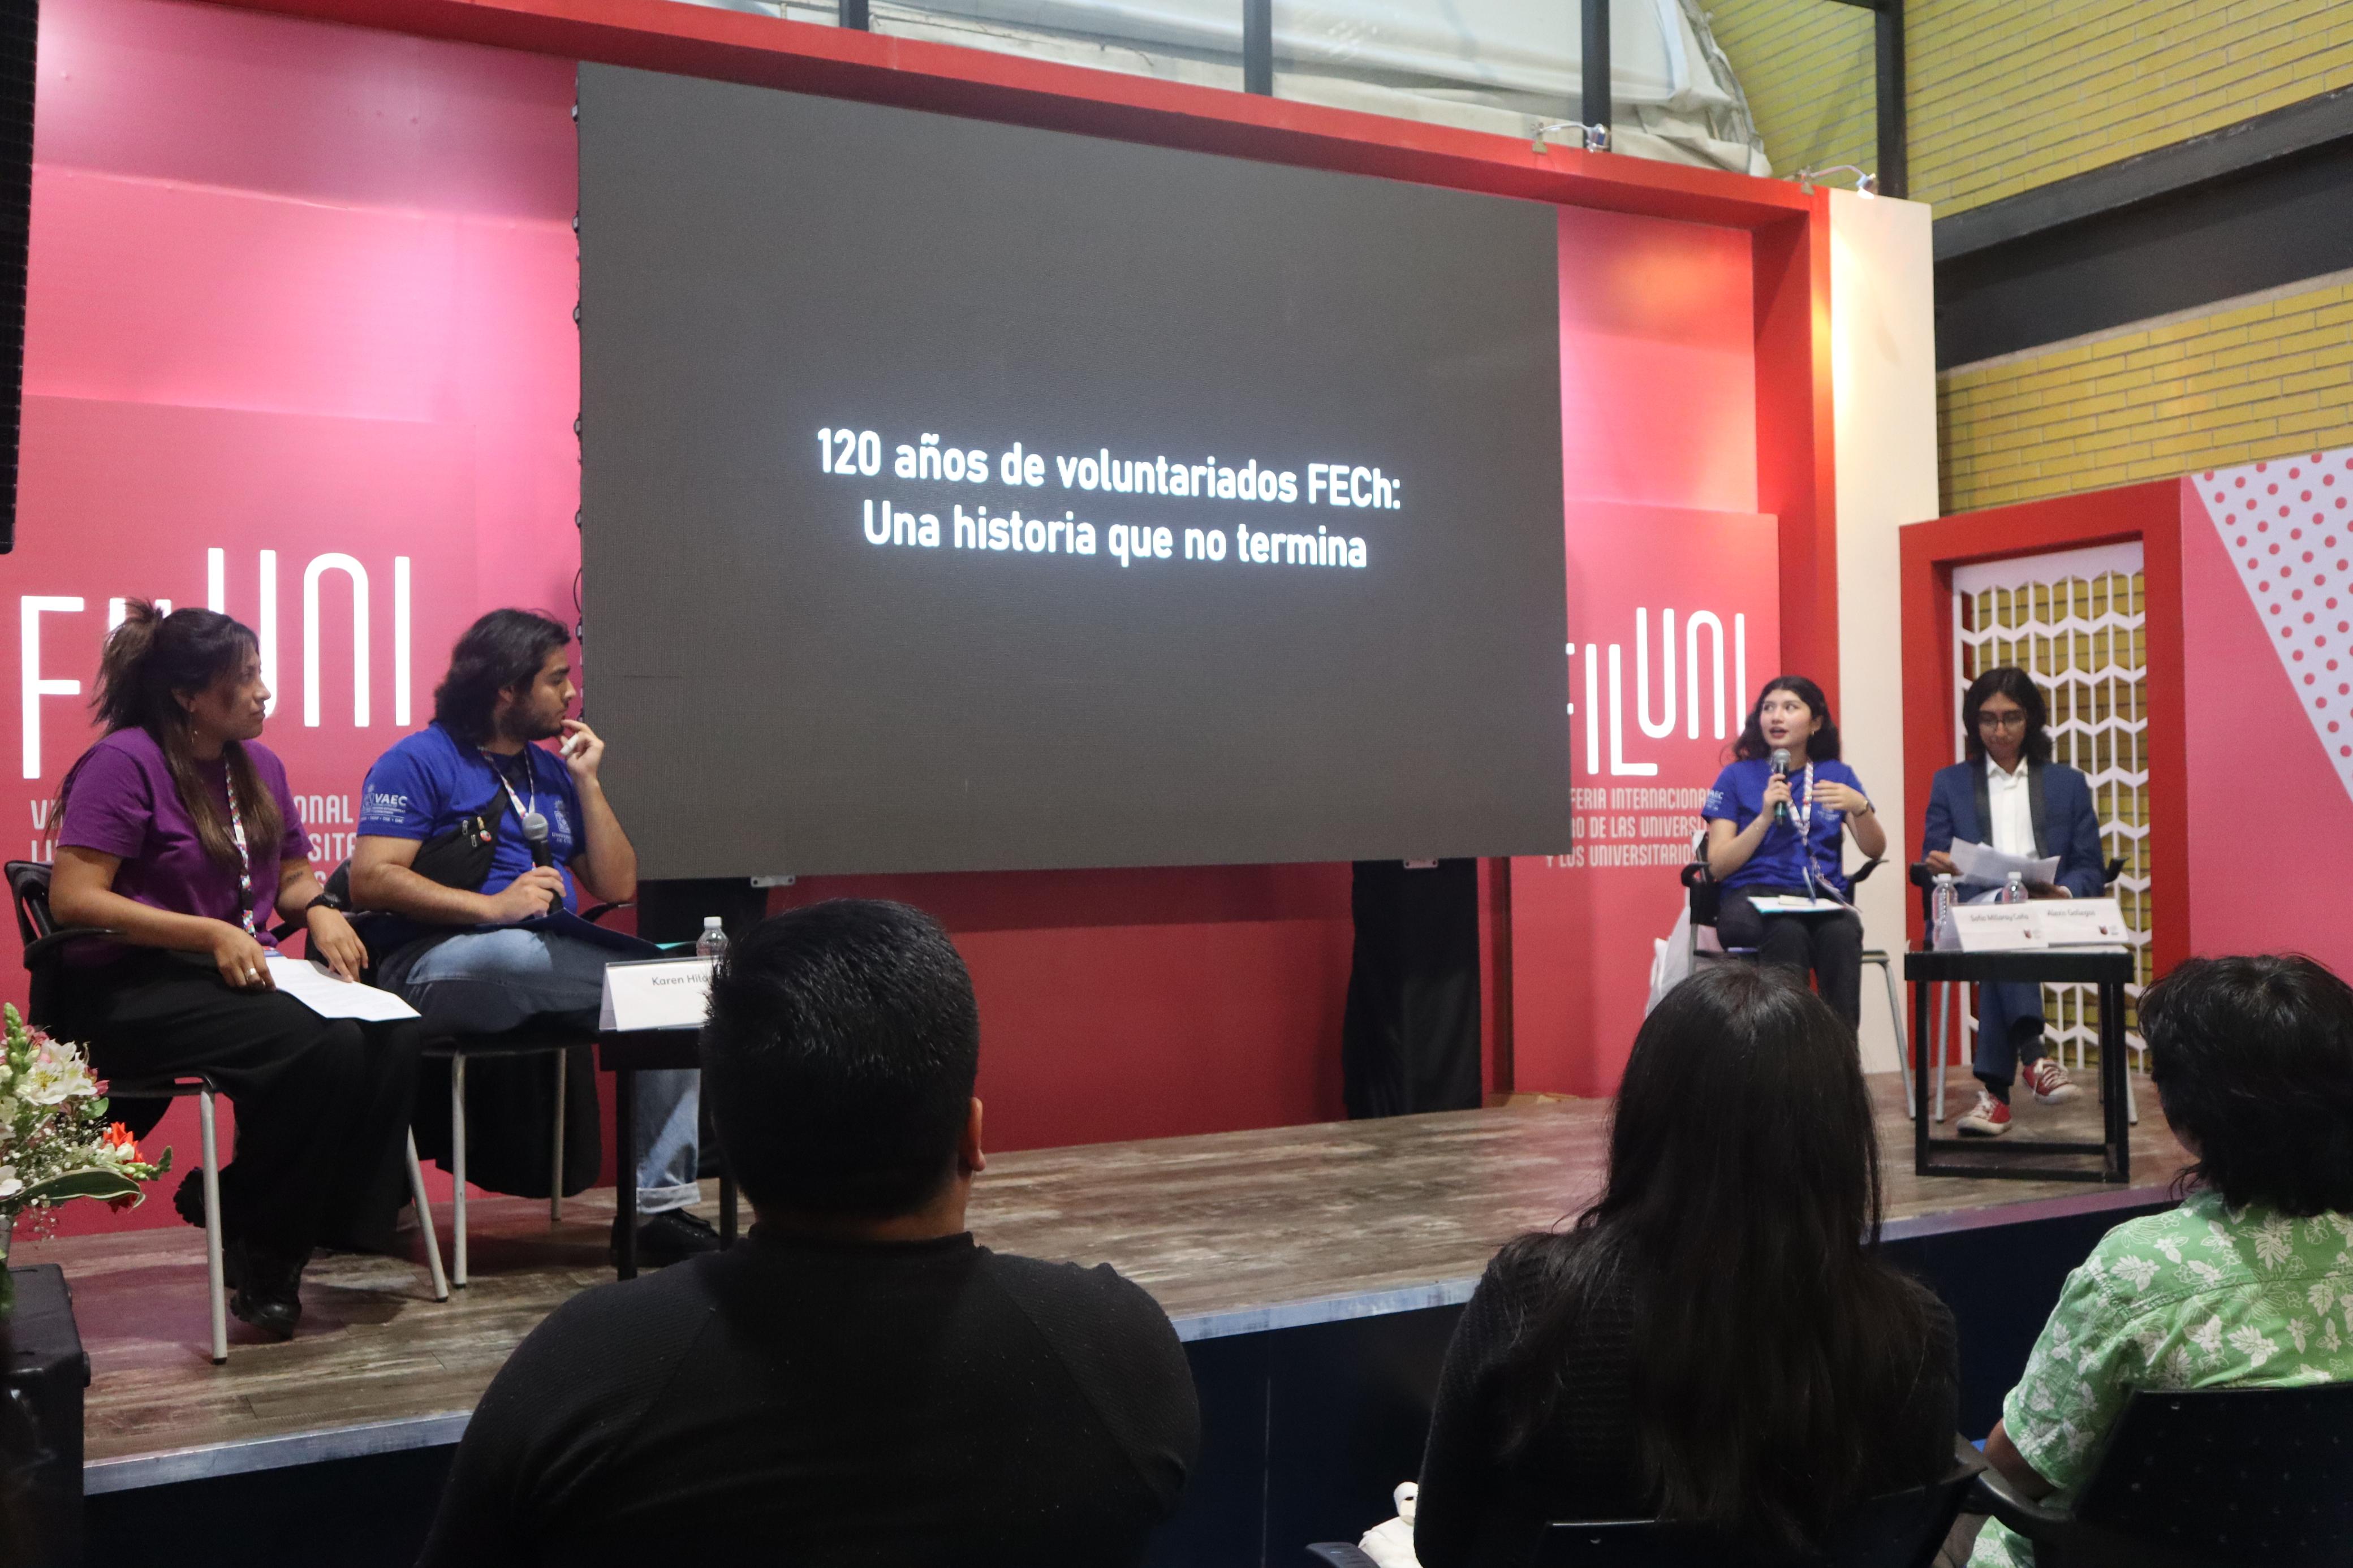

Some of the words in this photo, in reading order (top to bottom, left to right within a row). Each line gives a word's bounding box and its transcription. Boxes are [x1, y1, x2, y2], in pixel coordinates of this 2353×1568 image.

[817, 426, 882, 477] 120
[894, 432, 990, 484] años
[1000, 440, 1046, 488] de
[1055, 447, 1299, 504] voluntariados
[1307, 462, 1401, 510] FECh:
[863, 498, 941, 548] Una
[953, 503, 1097, 556] historia
[1107, 523, 1174, 568] que
[1184, 528, 1227, 562] no
[1236, 522, 1368, 569] termina
[375, 793, 408, 807] VAEC
[1590, 816, 1606, 839] DE
[1611, 816, 1636, 839] LAS
[1589, 844, 1691, 867] UNIVERSITARIO
[652, 976, 684, 986] Karen
[687, 974, 708, 983] Hila
